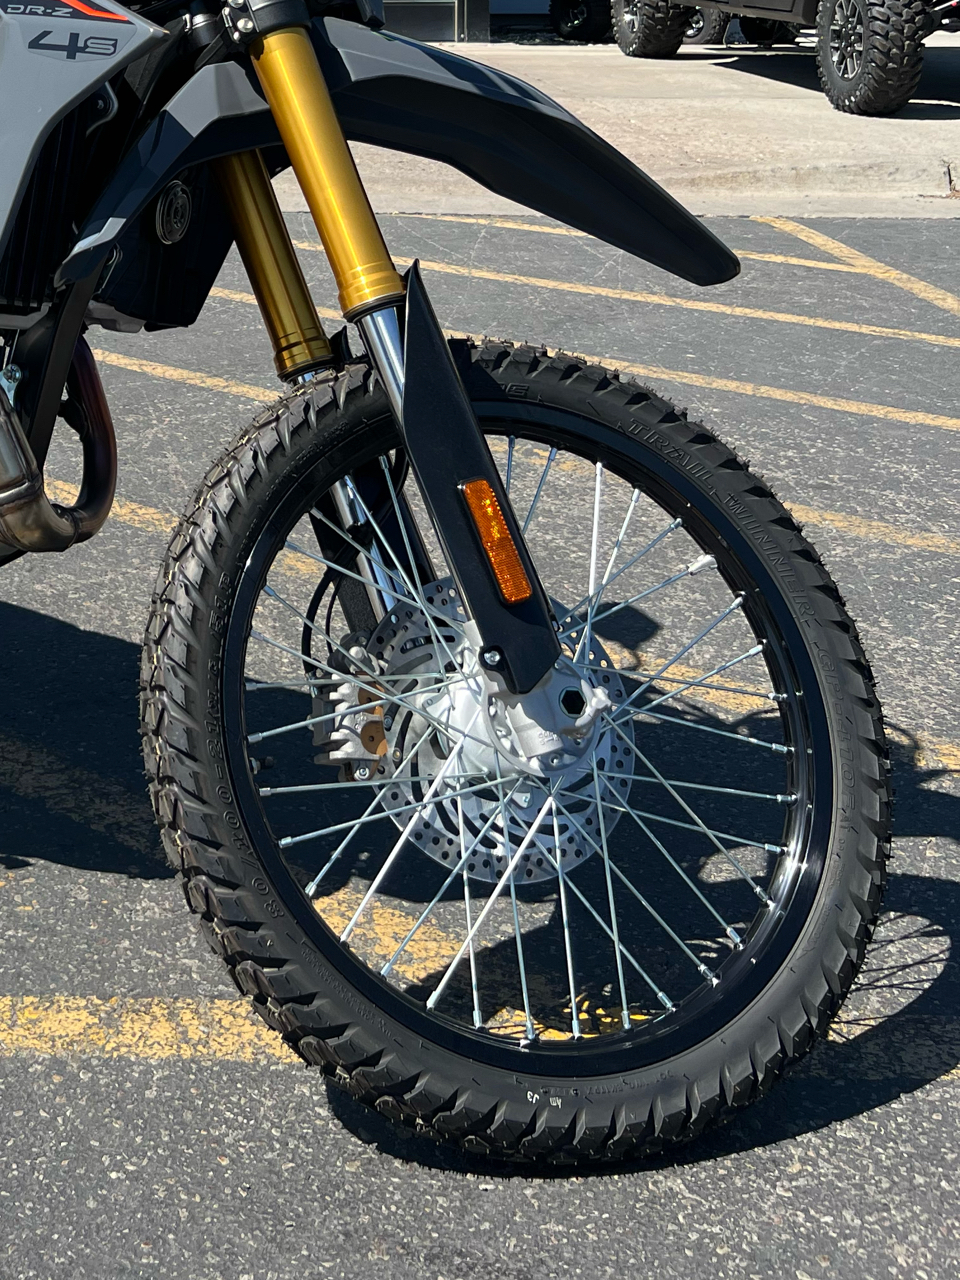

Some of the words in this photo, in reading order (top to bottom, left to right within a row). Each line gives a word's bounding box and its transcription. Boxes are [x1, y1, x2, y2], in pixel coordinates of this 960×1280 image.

[6, 4, 73, 17] DR-Z
[28, 30, 118, 60] 4S
[628, 417, 715, 488] TRAIL
[723, 492, 816, 617] WINNER
